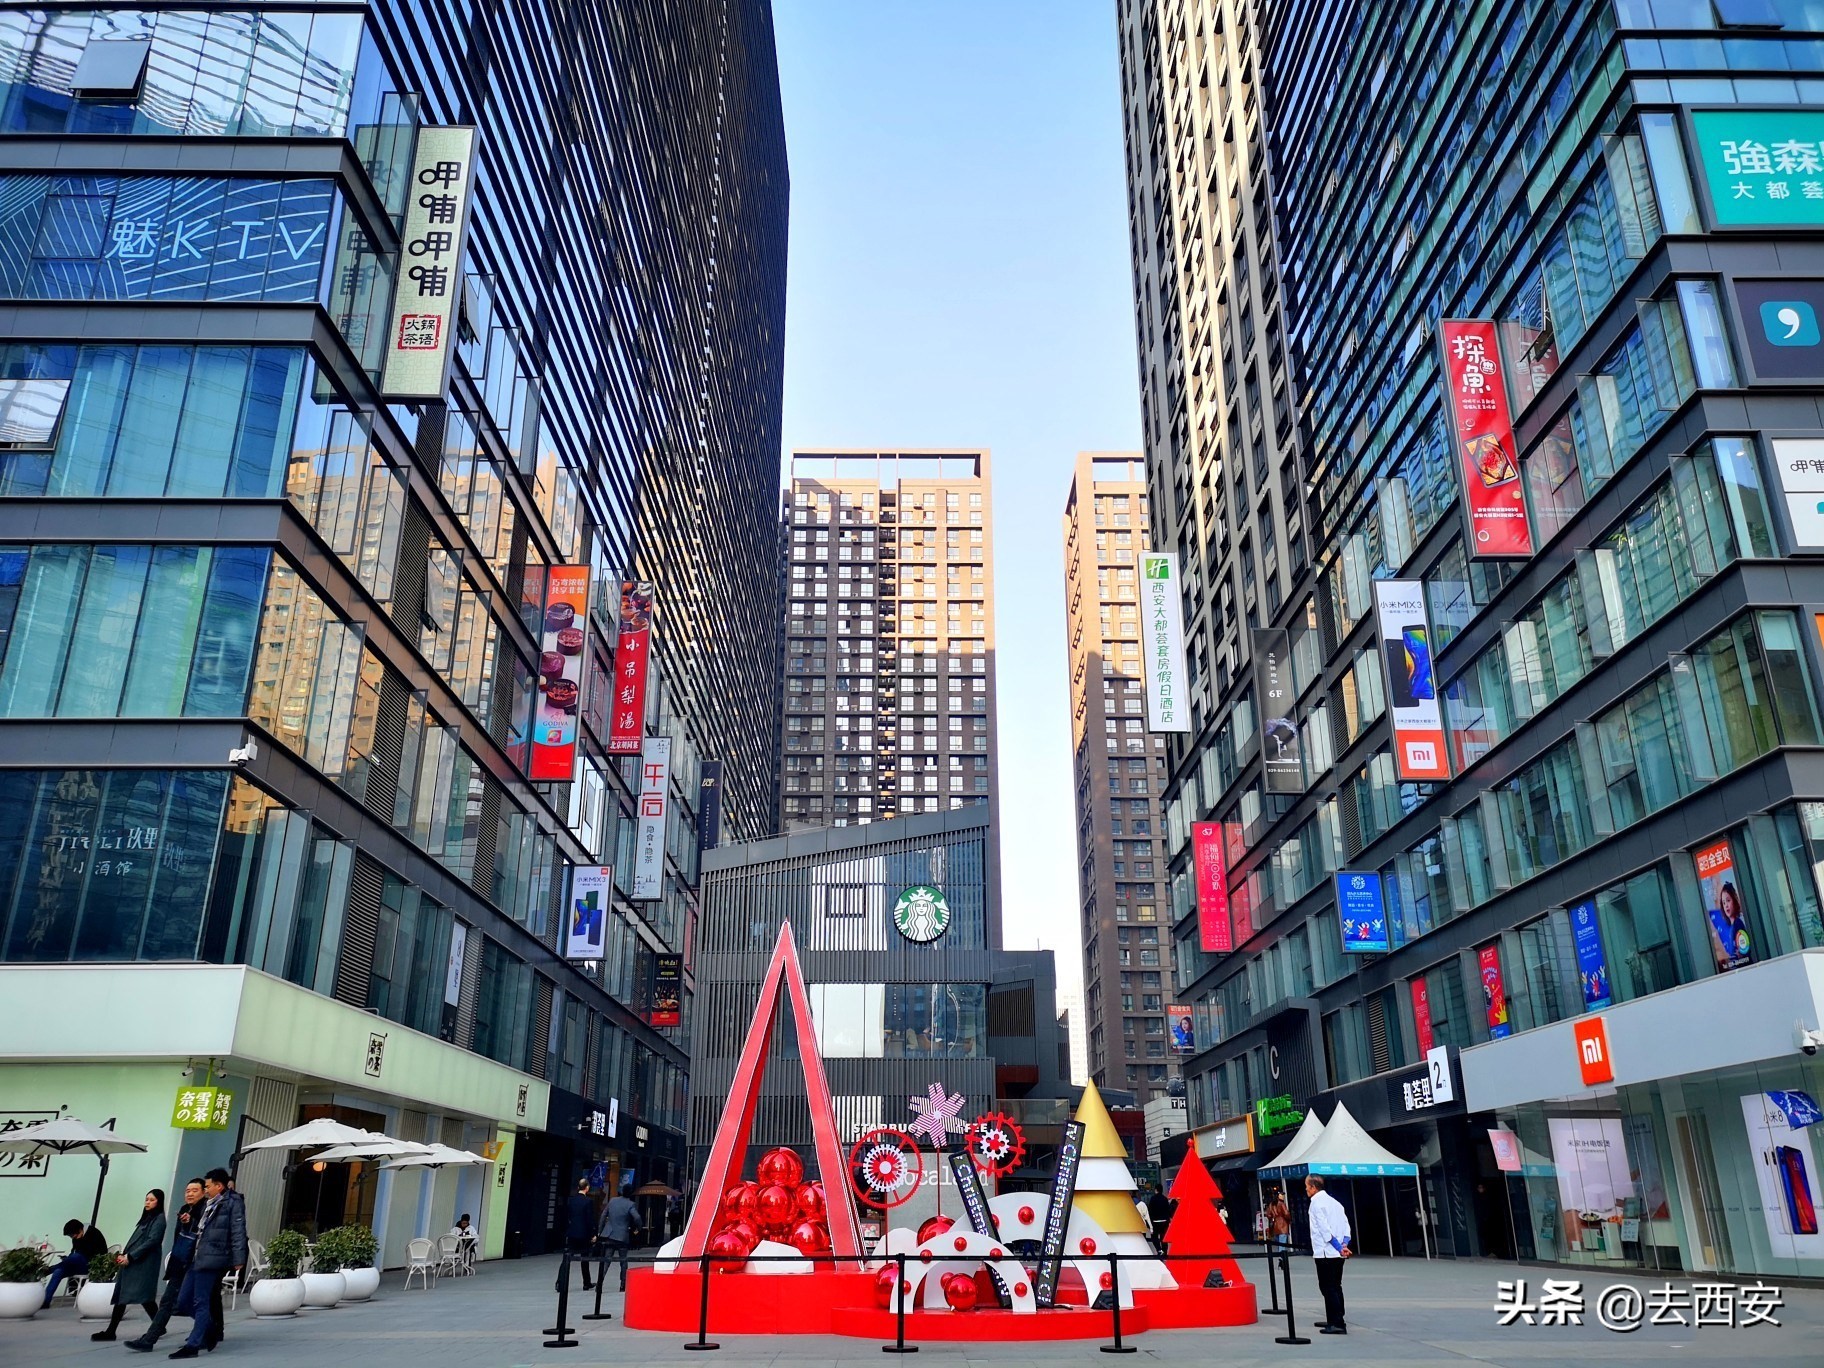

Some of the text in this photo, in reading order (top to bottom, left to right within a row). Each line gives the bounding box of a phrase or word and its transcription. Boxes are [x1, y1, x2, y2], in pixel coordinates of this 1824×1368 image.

[1720, 139, 1824, 175] 強森
[405, 319, 436, 331] 火锅
[403, 333, 434, 346] 茶语
[1152, 582, 1174, 723] 西安大都荟套房假日酒店
[1269, 690, 1283, 698] 6F
[542, 719, 569, 727] GODIVA
[1270, 1045, 1280, 1080] C
[180, 1091, 212, 1107] 奈雪
[177, 1107, 209, 1123] の茶
